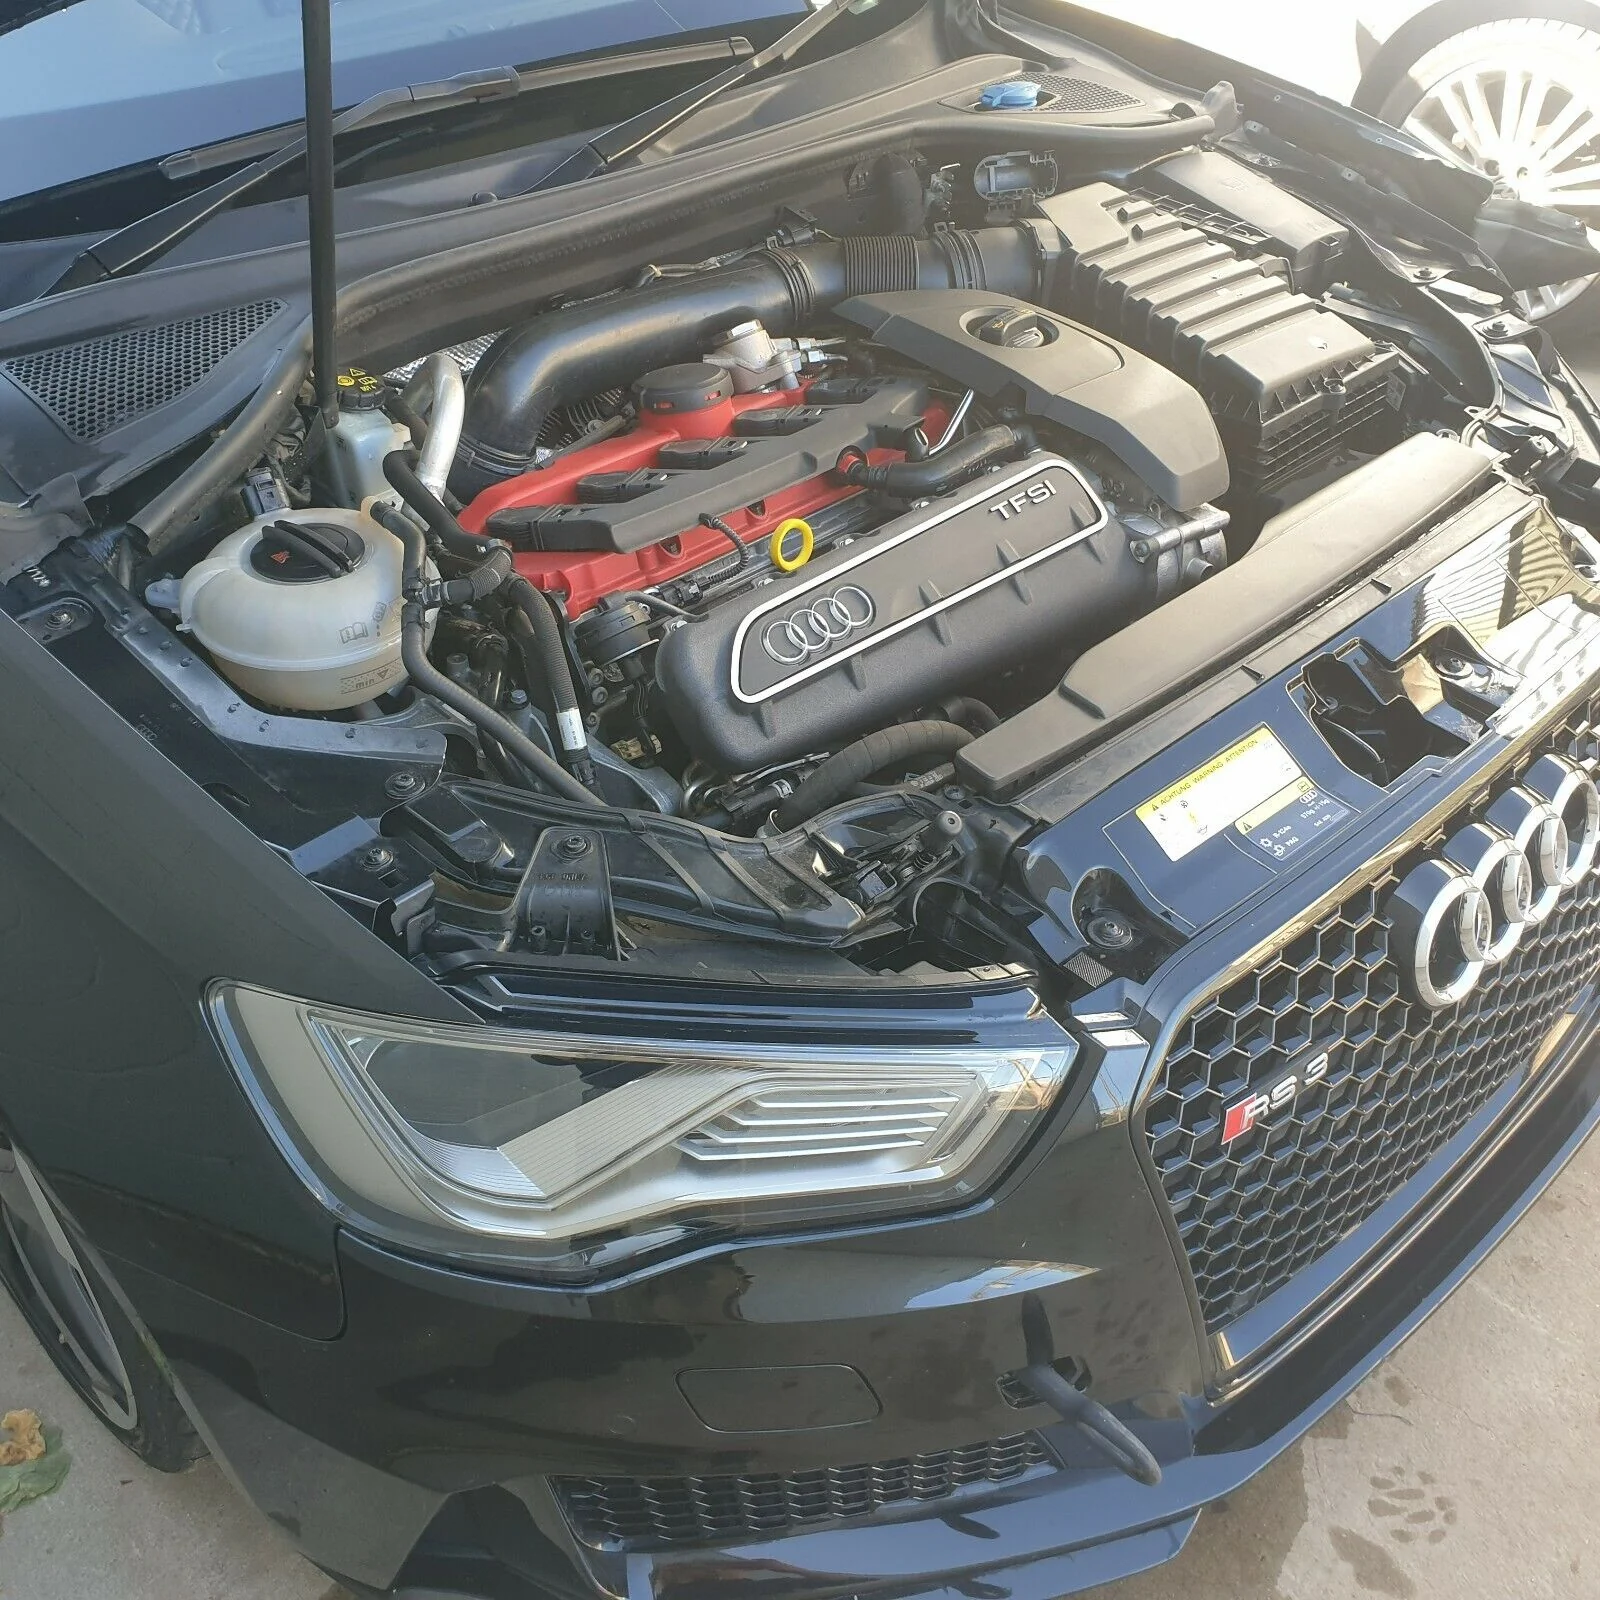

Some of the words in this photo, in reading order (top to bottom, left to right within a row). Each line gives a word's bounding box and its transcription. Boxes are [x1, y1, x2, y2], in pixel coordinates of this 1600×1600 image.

[989, 479, 1057, 520] TFSI
[355, 678, 375, 689] min
[1160, 782, 1191, 805] ACHTUNG
[1193, 761, 1224, 784] WARNING
[1225, 739, 1258, 762] ATTENTION
[1240, 1075, 1298, 1131] RS
[1304, 1052, 1329, 1086] 3
